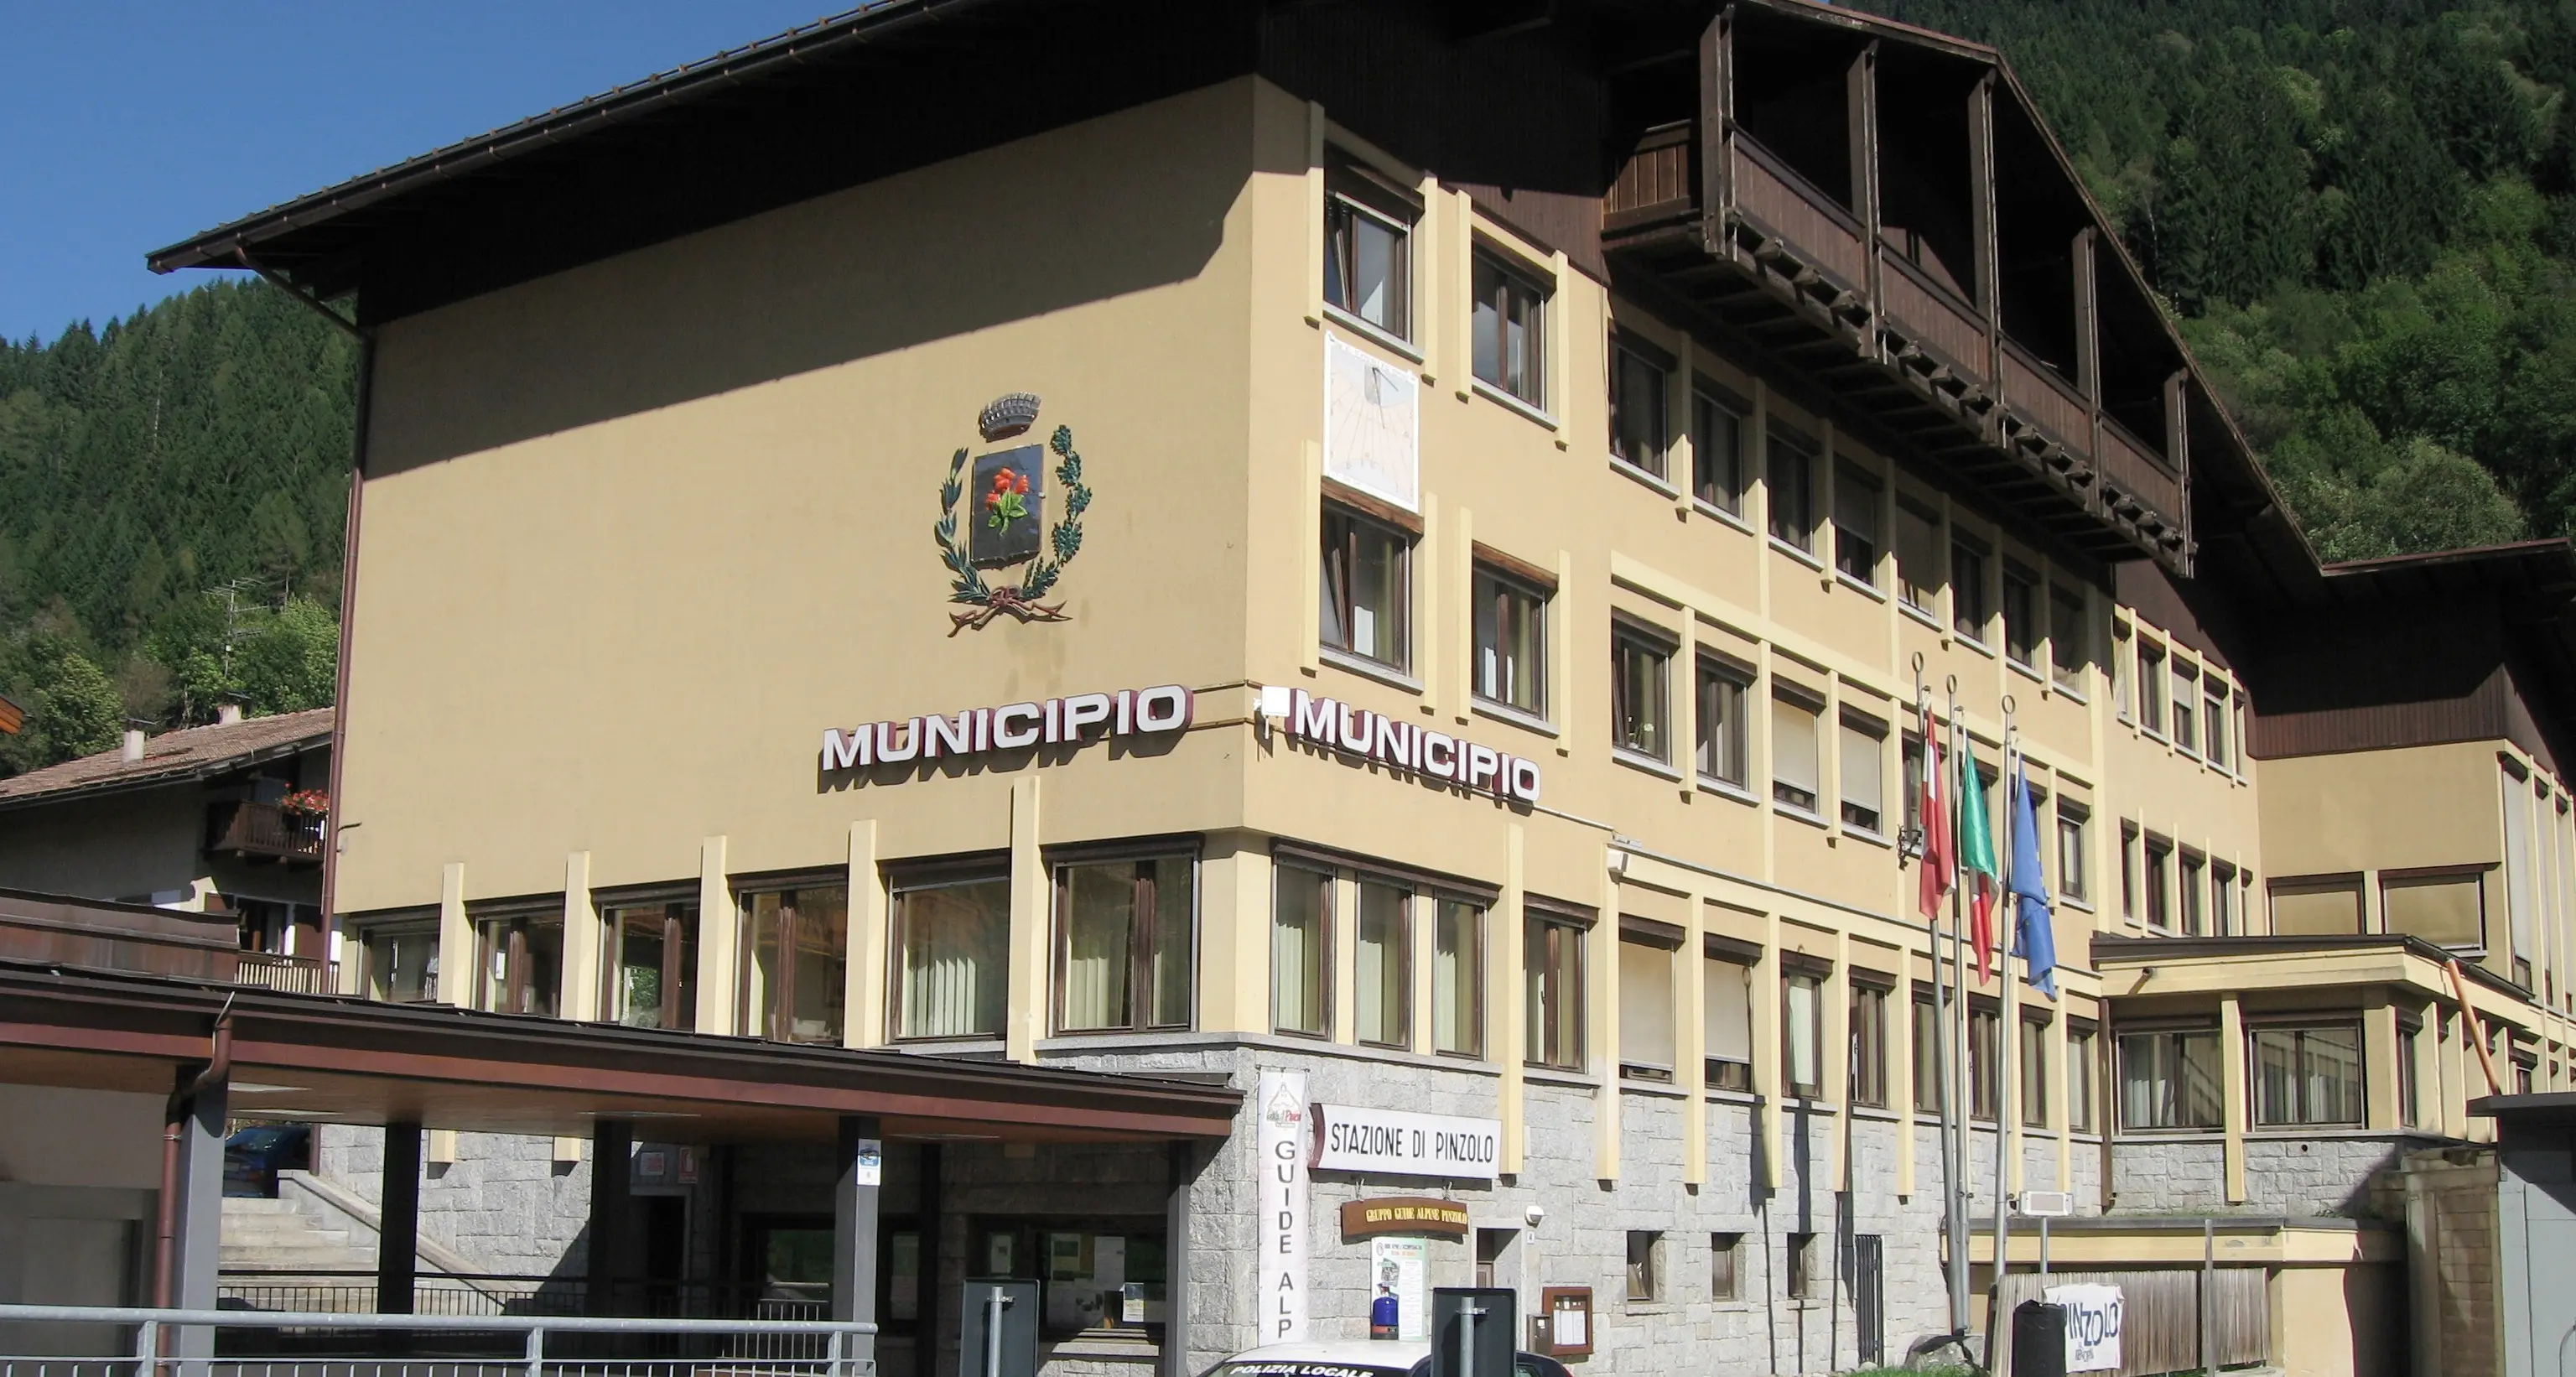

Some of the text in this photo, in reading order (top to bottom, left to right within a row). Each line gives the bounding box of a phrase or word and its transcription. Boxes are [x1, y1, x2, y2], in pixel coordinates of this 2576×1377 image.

[823, 684, 1192, 771] MUNICIPIO
[1290, 688, 1541, 803] MUNICIPIO
[1331, 1122, 1493, 1163] STAZIONE DI PINZOLO
[1275, 1140, 1296, 1254] GUIDE
[1365, 1207, 1467, 1224] GRUPPO GUIDE ALPINE PINZOLO
[1230, 1364, 1374, 1377] POLIZIA LOCALE
